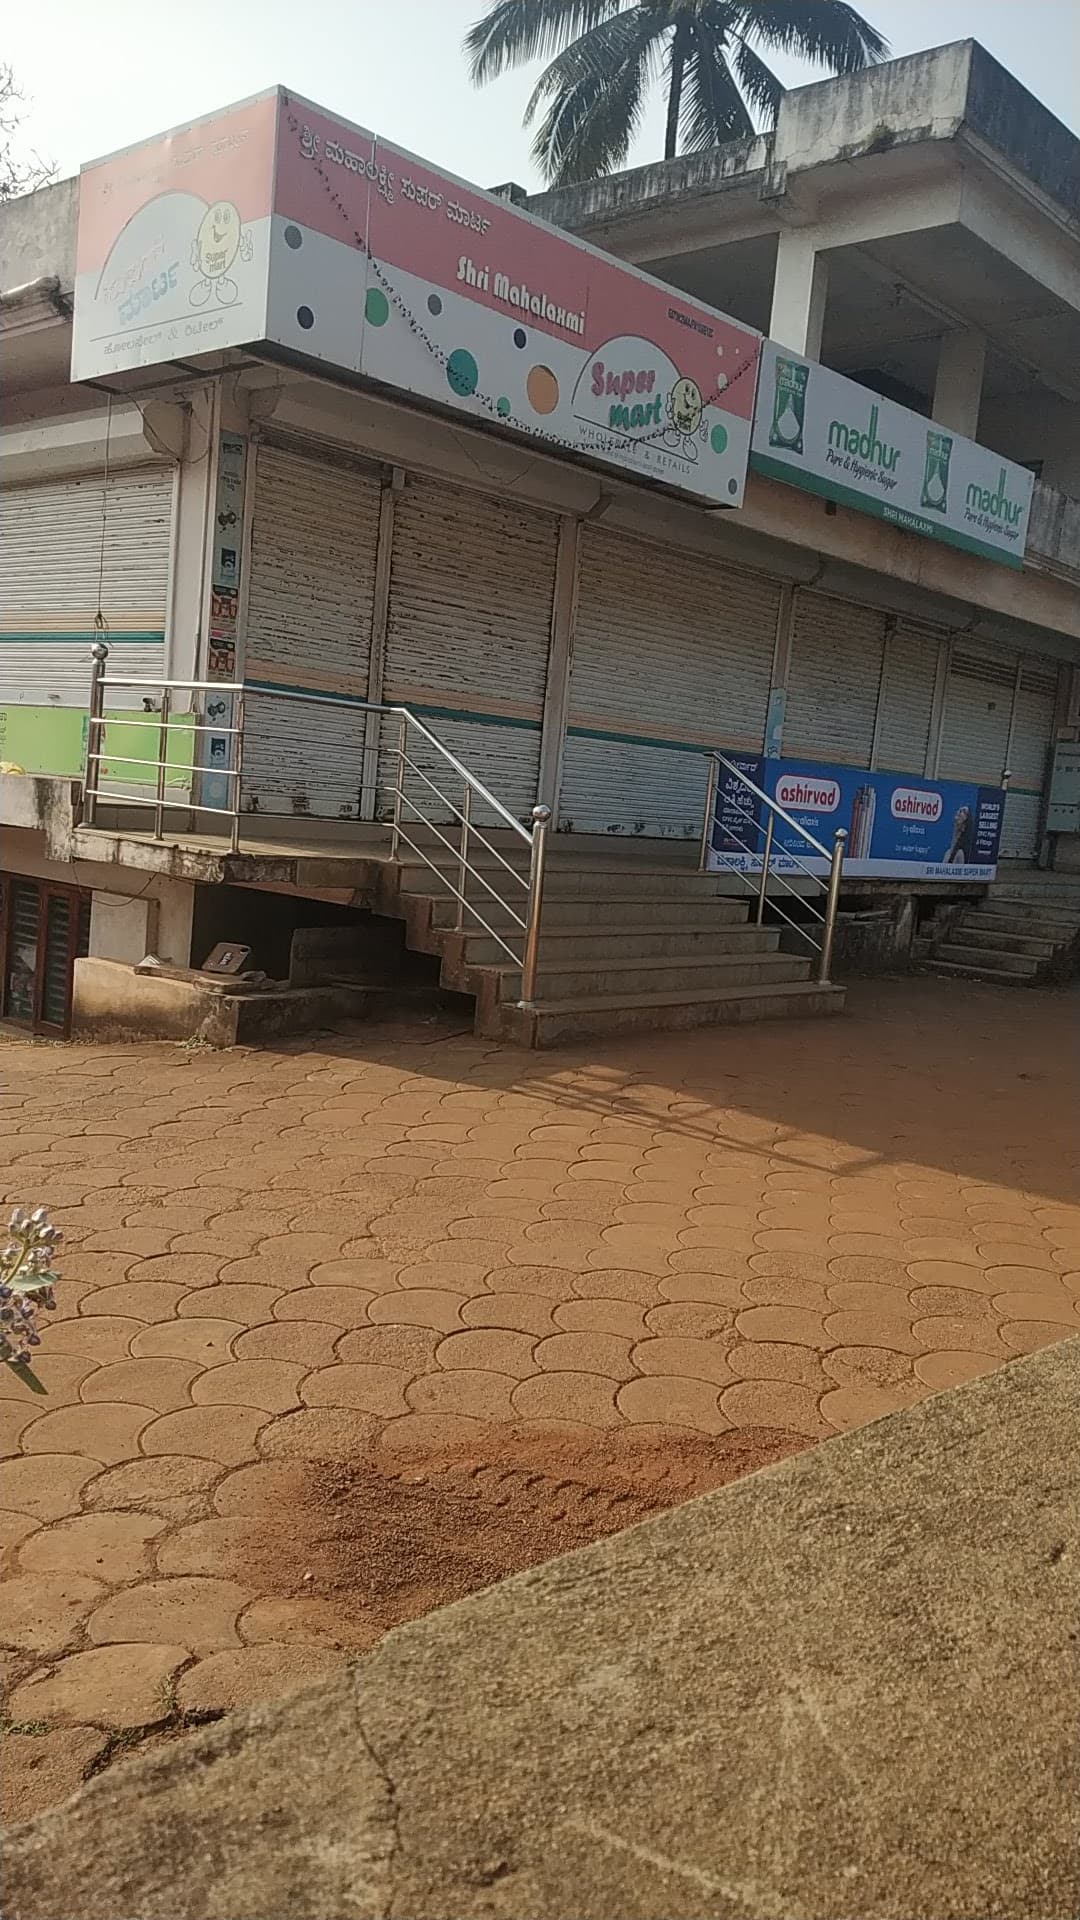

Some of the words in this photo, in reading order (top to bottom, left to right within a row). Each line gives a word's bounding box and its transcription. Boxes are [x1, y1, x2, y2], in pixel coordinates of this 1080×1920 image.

[456, 255, 490, 292] Shri
[493, 271, 586, 336] Mahalaxmi
[591, 360, 656, 402] Super
[609, 393, 662, 431] mart
[828, 404, 901, 472] madhur
[644, 450, 651, 460] &
[657, 455, 692, 475] RETAILS
[826, 448, 844, 468] Pure
[844, 456, 851, 469] &
[966, 467, 1023, 526] madhur
[781, 784, 836, 806] ashirvad
[895, 795, 939, 817] ashirvad
